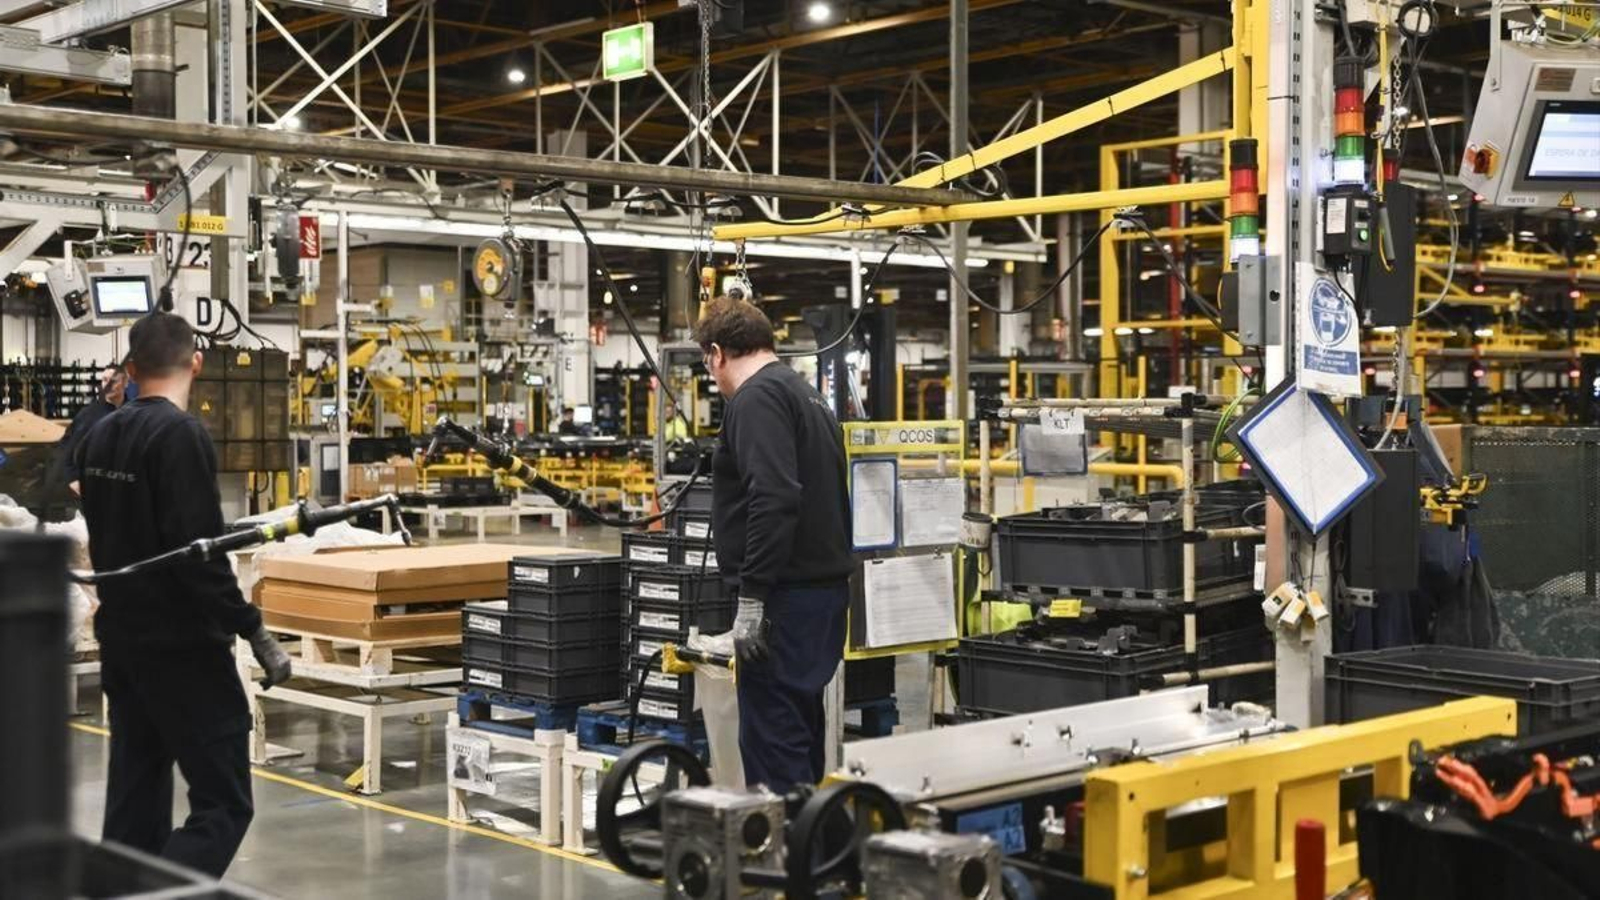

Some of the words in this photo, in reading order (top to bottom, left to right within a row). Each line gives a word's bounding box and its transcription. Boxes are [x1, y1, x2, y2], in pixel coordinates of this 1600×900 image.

[1584, 8, 1592, 22] G
[197, 297, 212, 326] D
[899, 429, 934, 444] QCOS
